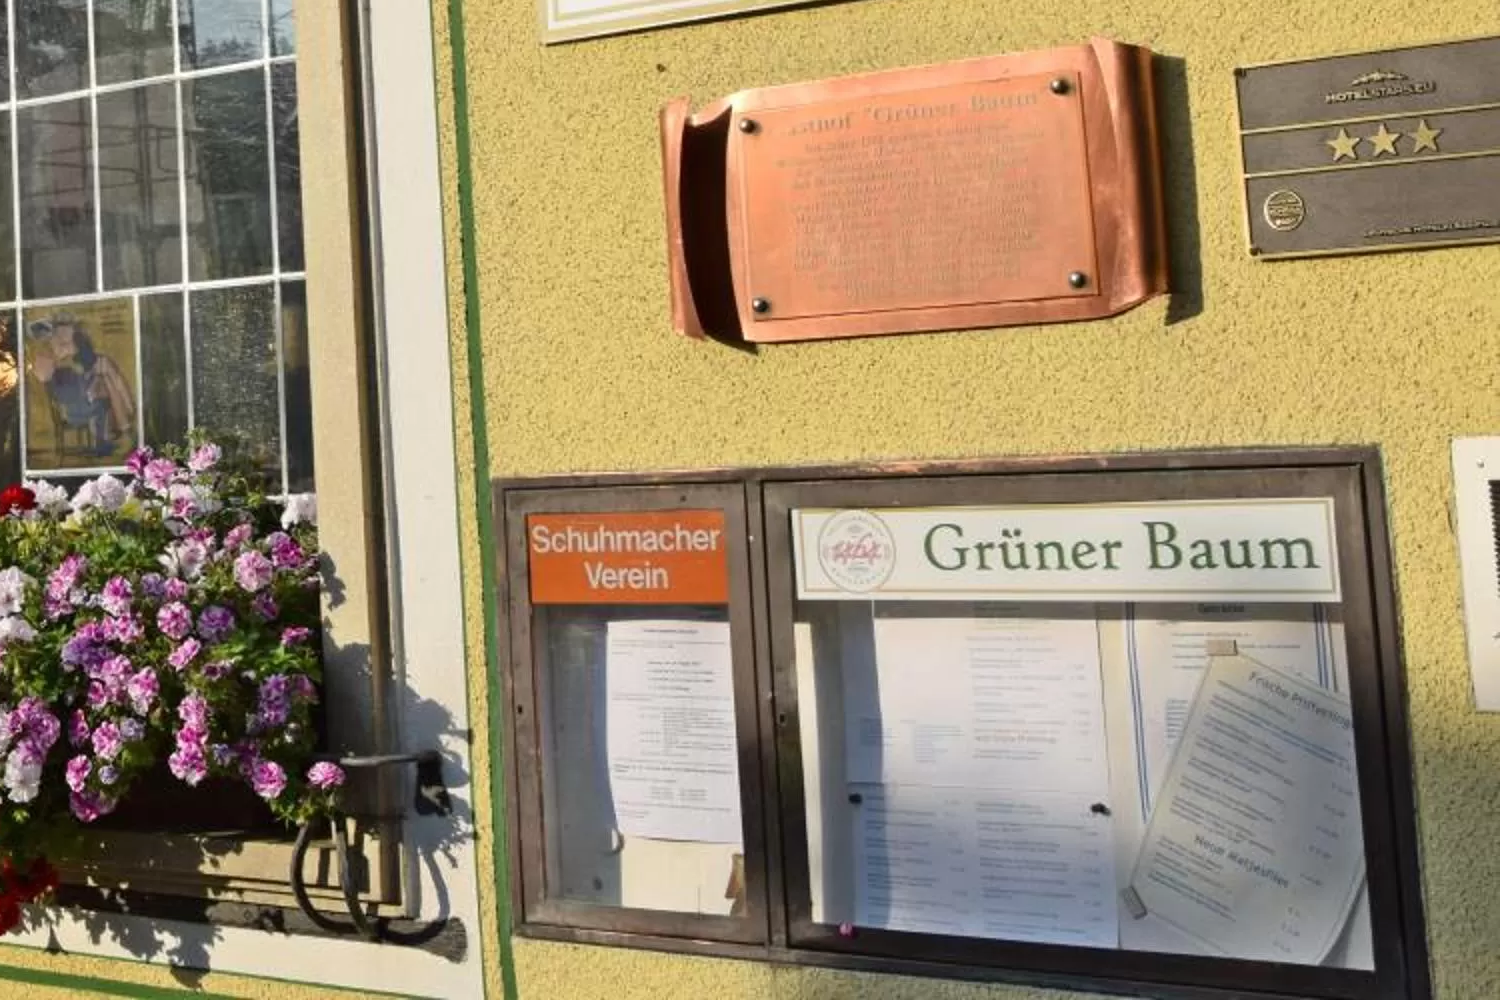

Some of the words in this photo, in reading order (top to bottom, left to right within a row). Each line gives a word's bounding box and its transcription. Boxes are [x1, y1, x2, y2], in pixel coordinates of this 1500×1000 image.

[531, 523, 720, 553] Schuhmacher
[924, 523, 1122, 571] Grüner
[1142, 521, 1321, 569] Baum
[585, 561, 669, 589] Verein
